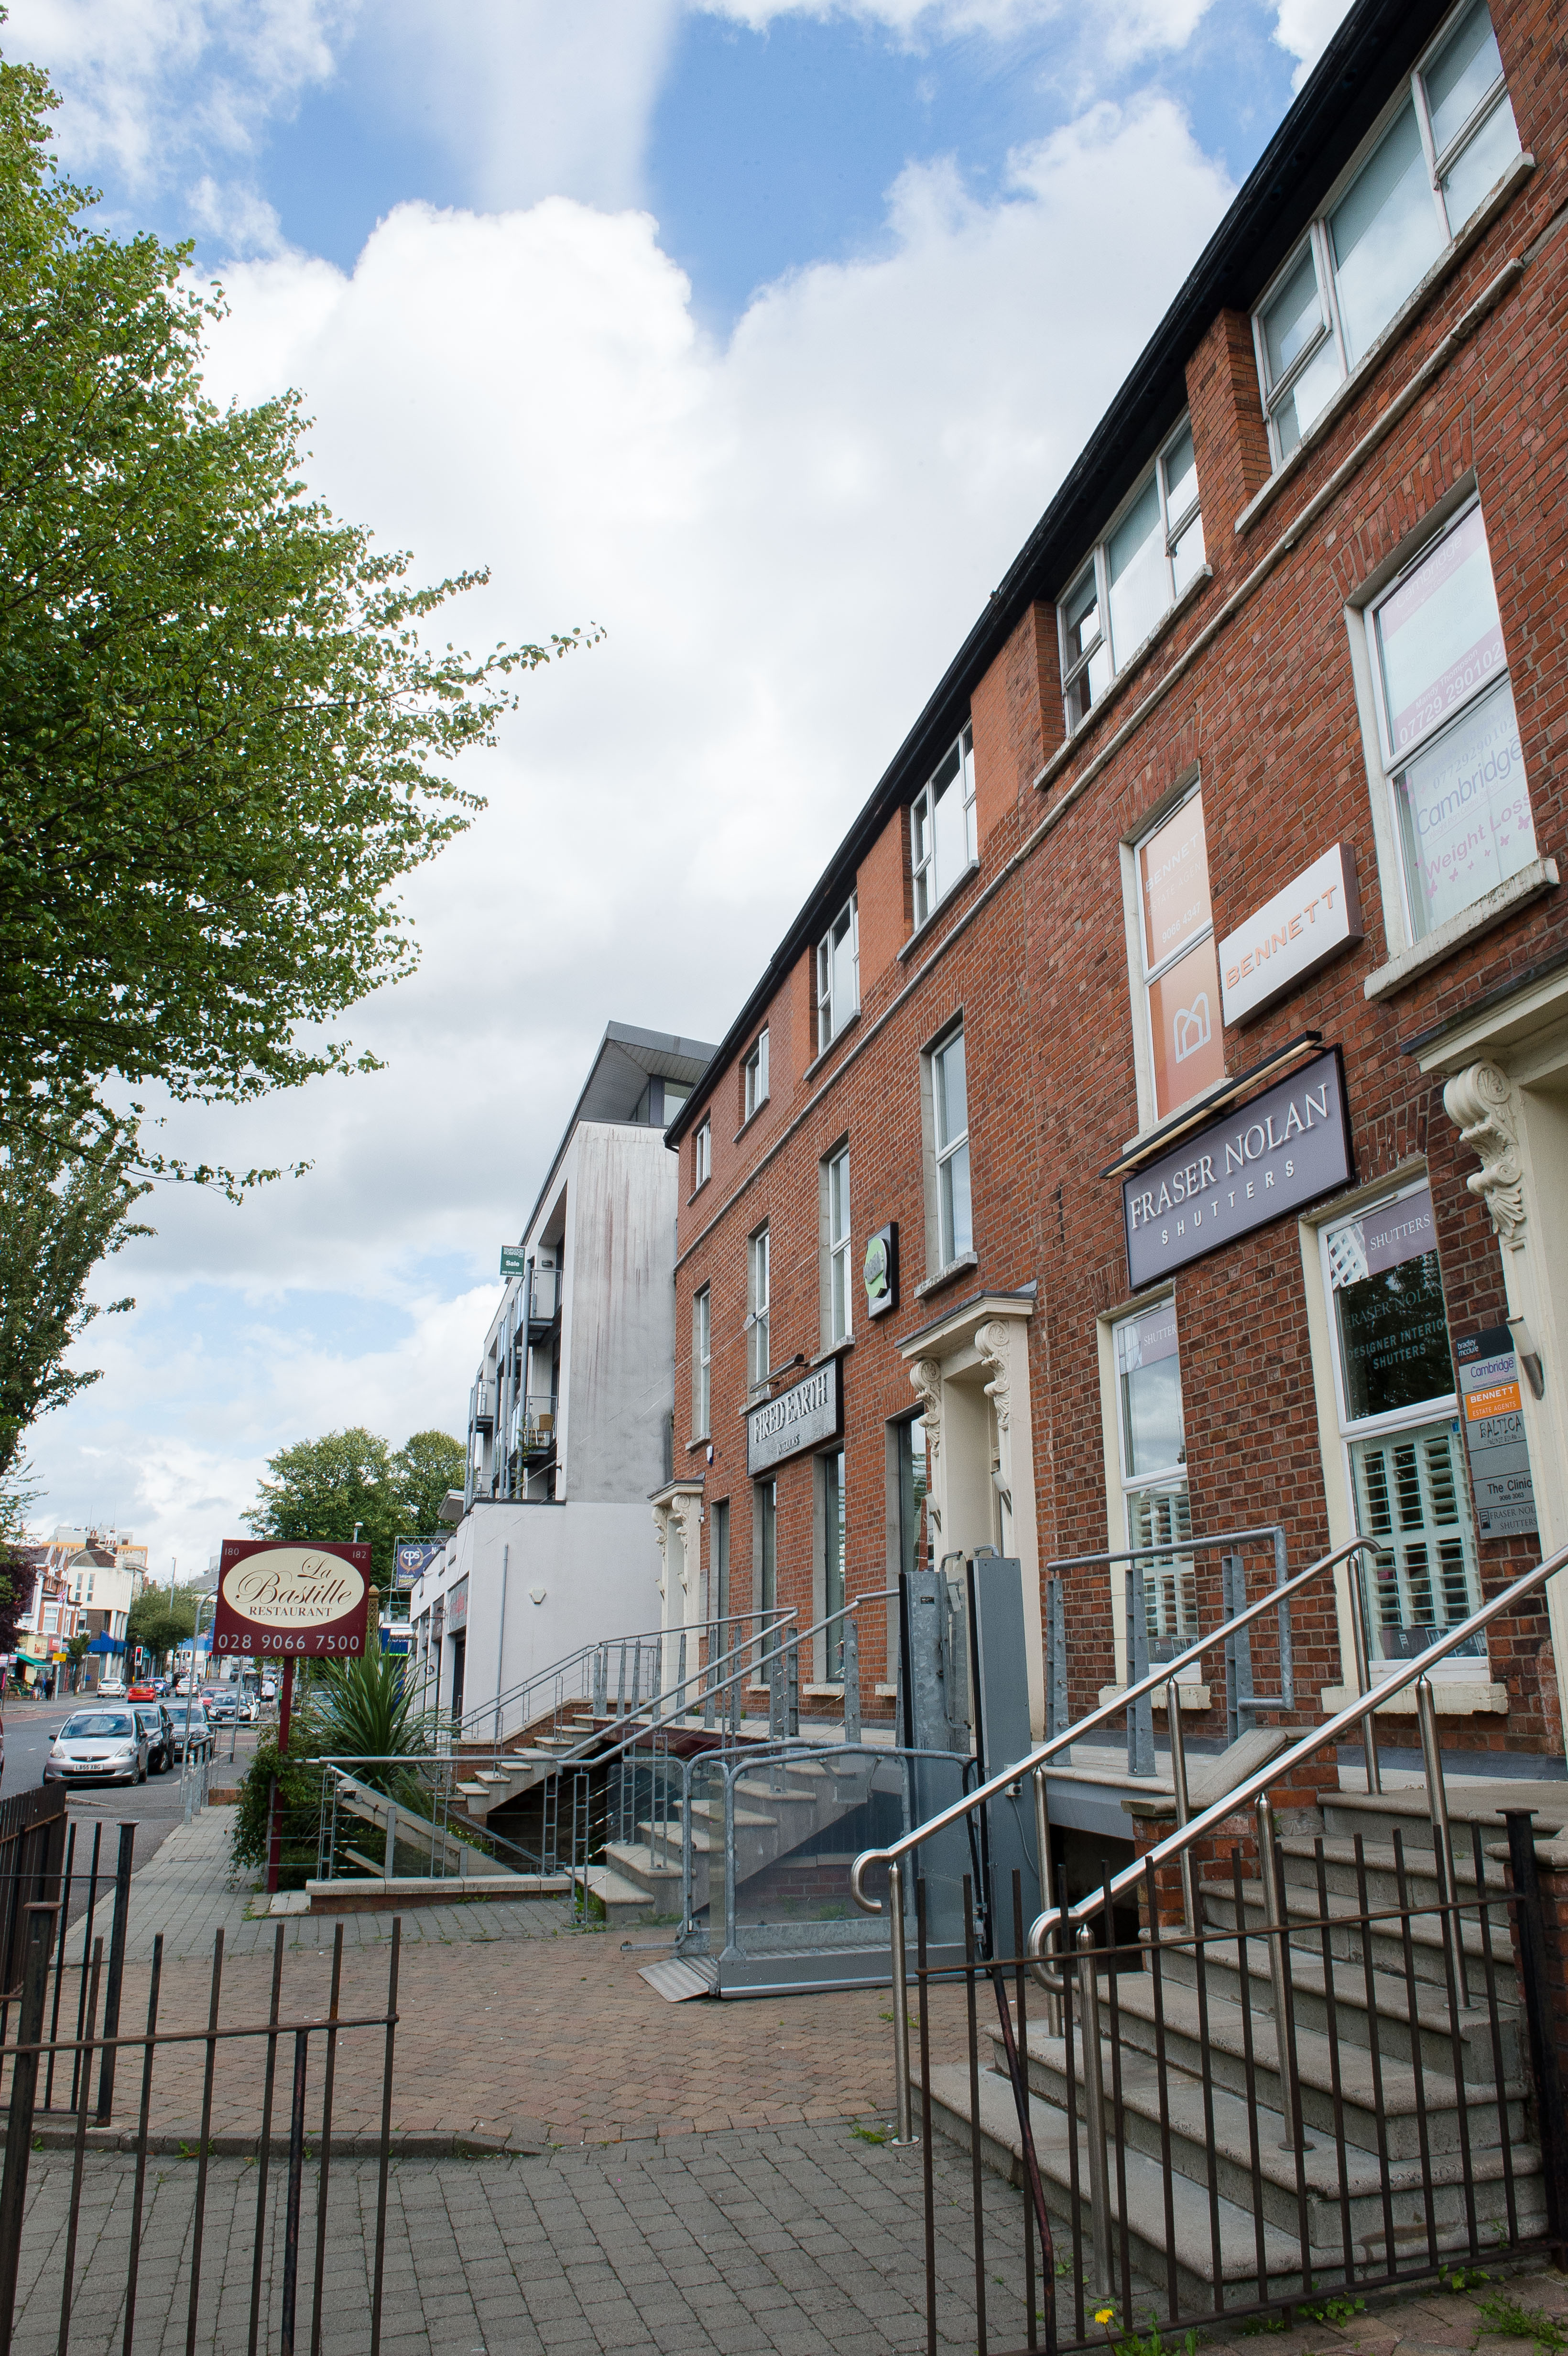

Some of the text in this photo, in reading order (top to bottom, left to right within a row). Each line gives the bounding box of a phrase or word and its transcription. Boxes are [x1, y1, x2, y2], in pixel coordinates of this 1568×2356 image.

[1397, 533, 1462, 608] Cambridge
[1434, 557, 1462, 588] Consultant
[1399, 697, 1442, 745] 07729
[1446, 641, 1503, 703] 290102
[1416, 649, 1478, 709] Mandy Thompson
[1416, 734, 1523, 836] Cambridge
[1426, 793, 1530, 880] Weight Loss
[1146, 827, 1205, 893] BENNETT
[1148, 884, 1175, 917] ESTATE
[1162, 900, 1201, 944] 9066 4347
[1225, 884, 1337, 990] BENNETT
[1130, 1083, 1328, 1230] FRASER NOLAN
[1162, 1159, 1295, 1245] SHUTTERS
[1370, 1213, 1431, 1251] SHUTTERS
[1344, 1281, 1443, 1330] FRASER NOLAN
[1348, 1318, 1445, 1361] DESIGNER INTERIO
[1457, 1339, 1476, 1350] bradley
[1459, 1345, 1479, 1357] mcclure
[1373, 1342, 1426, 1369] SHUTTERS
[1460, 1353, 1481, 1363] architects
[1470, 1357, 1514, 1378] Cambridge
[754, 1372, 828, 1443] FIRED EARTH
[1470, 1386, 1514, 1404] BENNETT
[1472, 1401, 1517, 1417] ESTATE AGENTS
[1479, 1415, 1523, 1439] BALTICA
[777, 1434, 800, 1455] INTERIORS
[1487, 1478, 1532, 1494] The Clinic
[1490, 1506, 1536, 1519] FRASER NOL
[1500, 1517, 1537, 1530] SHUTTERS
[297, 1556, 333, 1580] La
[352, 1550, 366, 1559] 182
[403, 1550, 420, 1566] cps
[235, 1570, 353, 1604] Bastille
[249, 1606, 333, 1617] RESTAURANT
[218, 1634, 359, 1650] 028 9066 7500
